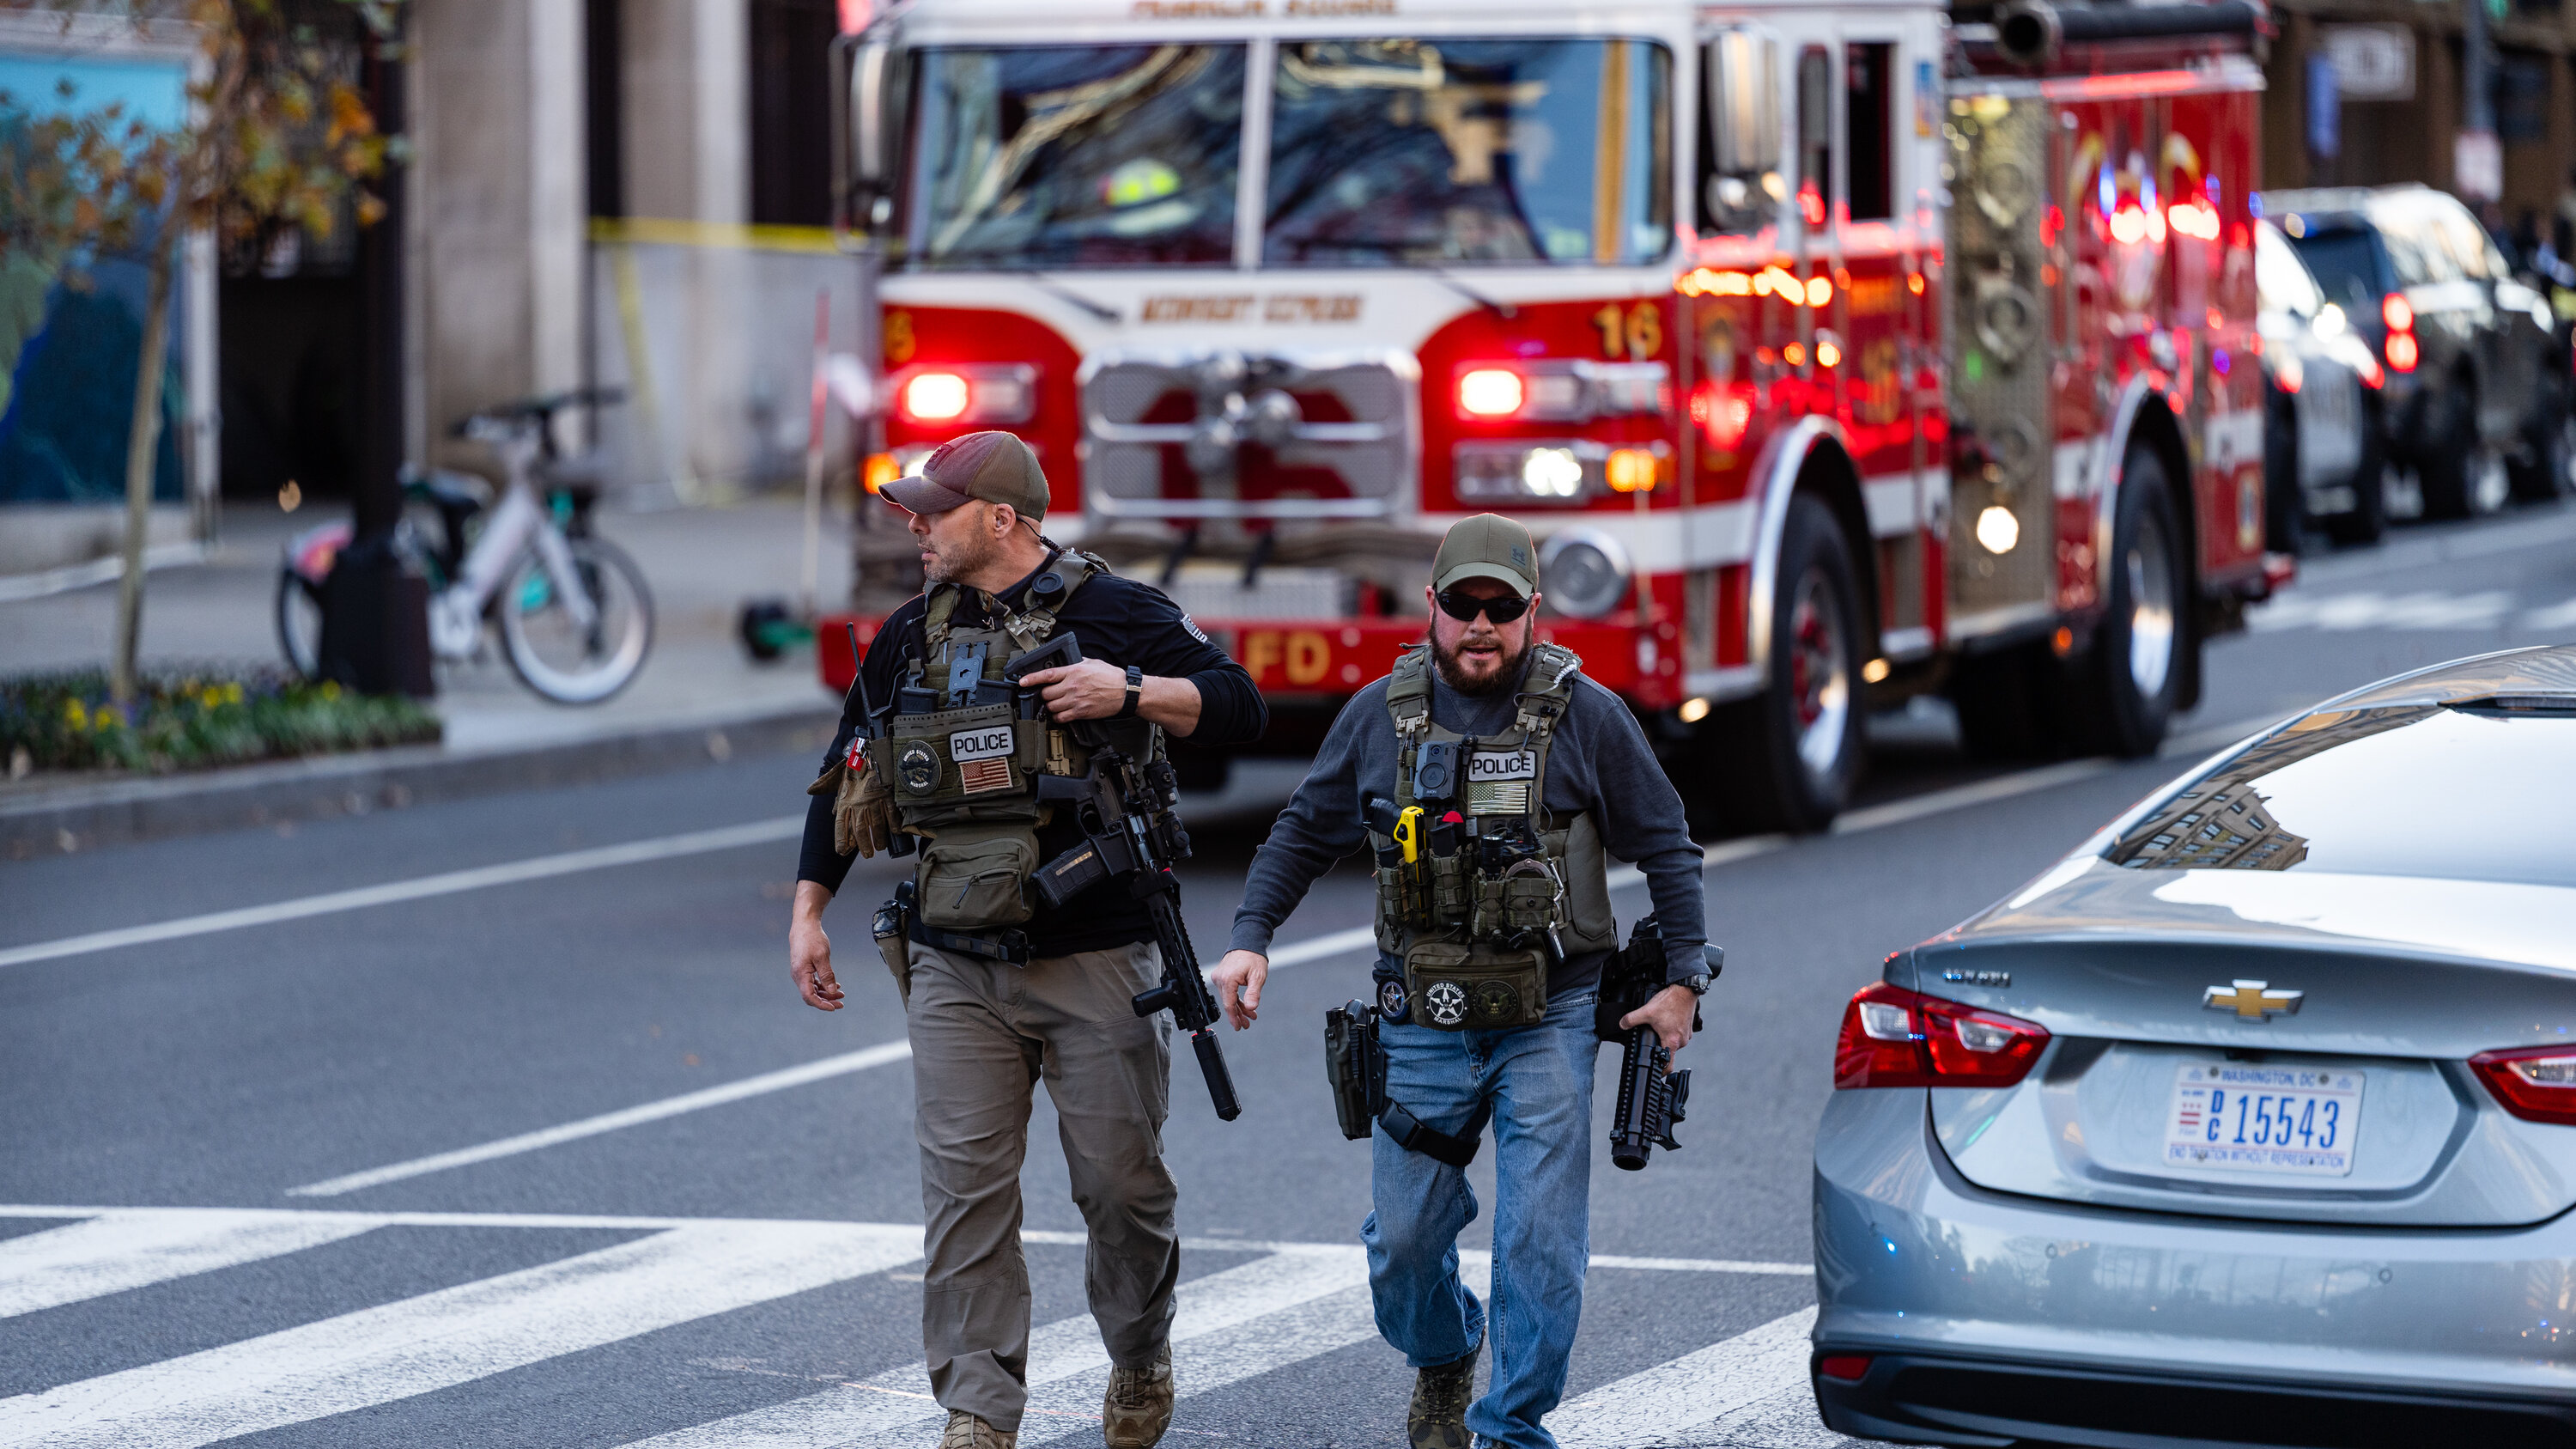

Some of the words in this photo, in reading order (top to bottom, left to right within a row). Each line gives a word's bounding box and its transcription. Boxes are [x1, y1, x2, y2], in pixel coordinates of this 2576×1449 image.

[1592, 301, 1662, 358] 16
[1245, 632, 1331, 685] FD
[954, 733, 1009, 754] POLICE
[903, 749, 915, 762] UNITED
[916, 749, 929, 762] STATES
[1472, 758, 1531, 775] POLICE
[1426, 983, 1444, 996] UNITED
[1446, 983, 1465, 999] STATES
[1433, 1016, 1462, 1025] MARSHAL
[2300, 1074, 2316, 1087] DC
[2233, 1094, 2340, 1148] 15543
